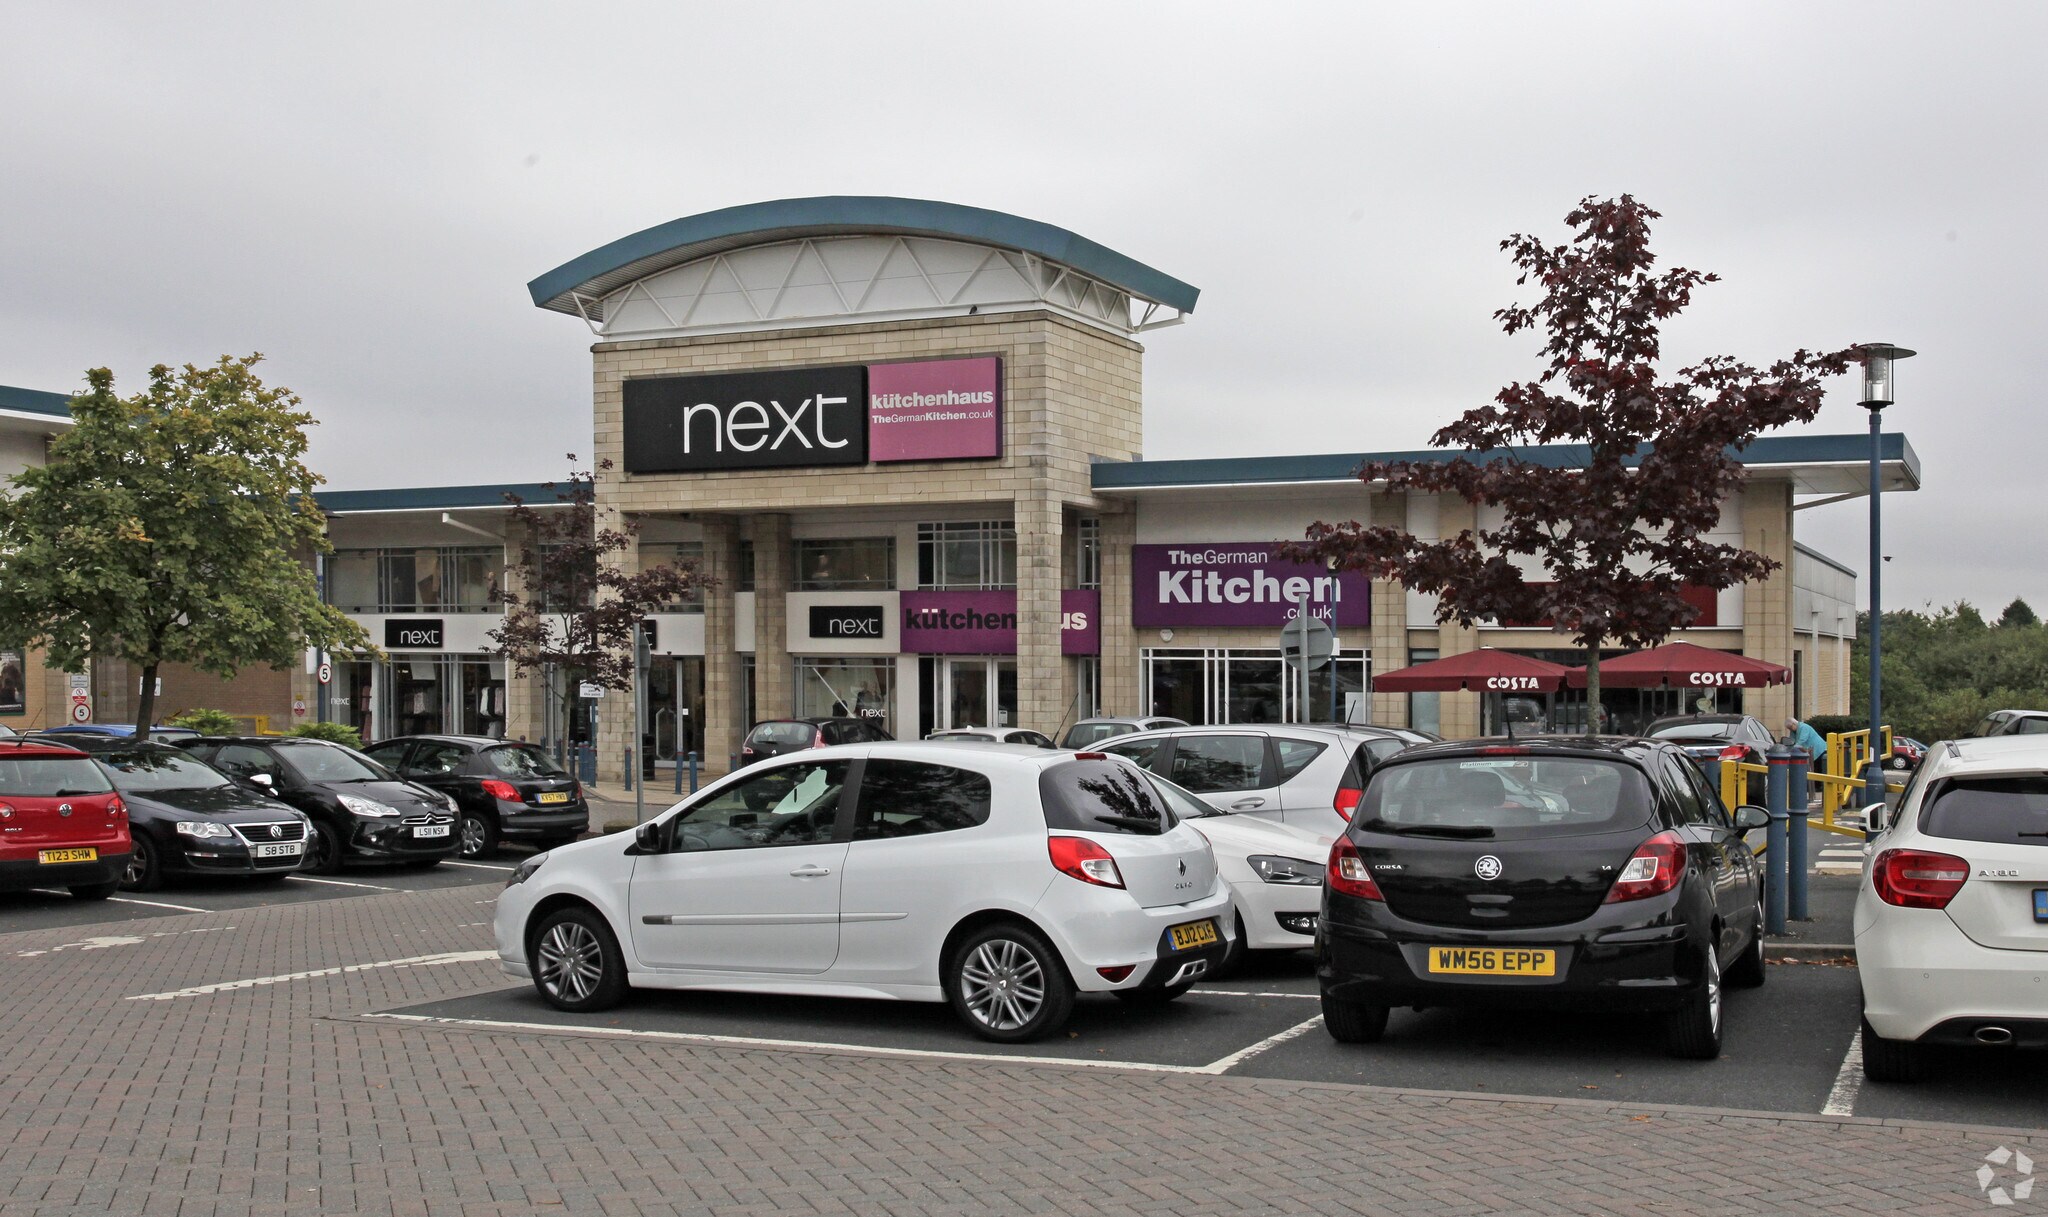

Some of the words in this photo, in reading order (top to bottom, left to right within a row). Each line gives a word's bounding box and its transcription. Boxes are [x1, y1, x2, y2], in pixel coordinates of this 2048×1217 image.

[872, 390, 994, 409] kütchenhaus
[872, 409, 994, 424] TheGermanKitchen.co.uk
[683, 394, 848, 454] next
[1168, 549, 1268, 565] TheGerman
[1159, 569, 1341, 604] Kitchen
[1282, 604, 1332, 619] .cuk
[829, 618, 879, 635] next
[400, 629, 440, 645] next
[322, 668, 328, 680] 5
[1690, 672, 1746, 685] COSTA
[1487, 677, 1540, 689] COSTA
[330, 697, 350, 706] next
[79, 709, 85, 717] 5
[861, 708, 886, 718] next
[432, 827, 445, 835] NSK
[45, 852, 69, 861] T123
[72, 850, 91, 860] SHM
[265, 846, 276, 855] S8
[1978, 869, 2019, 877] A180
[1175, 926, 1198, 946] BJ12
[1439, 950, 1495, 970] WM56
[1502, 952, 1546, 971] EPP
